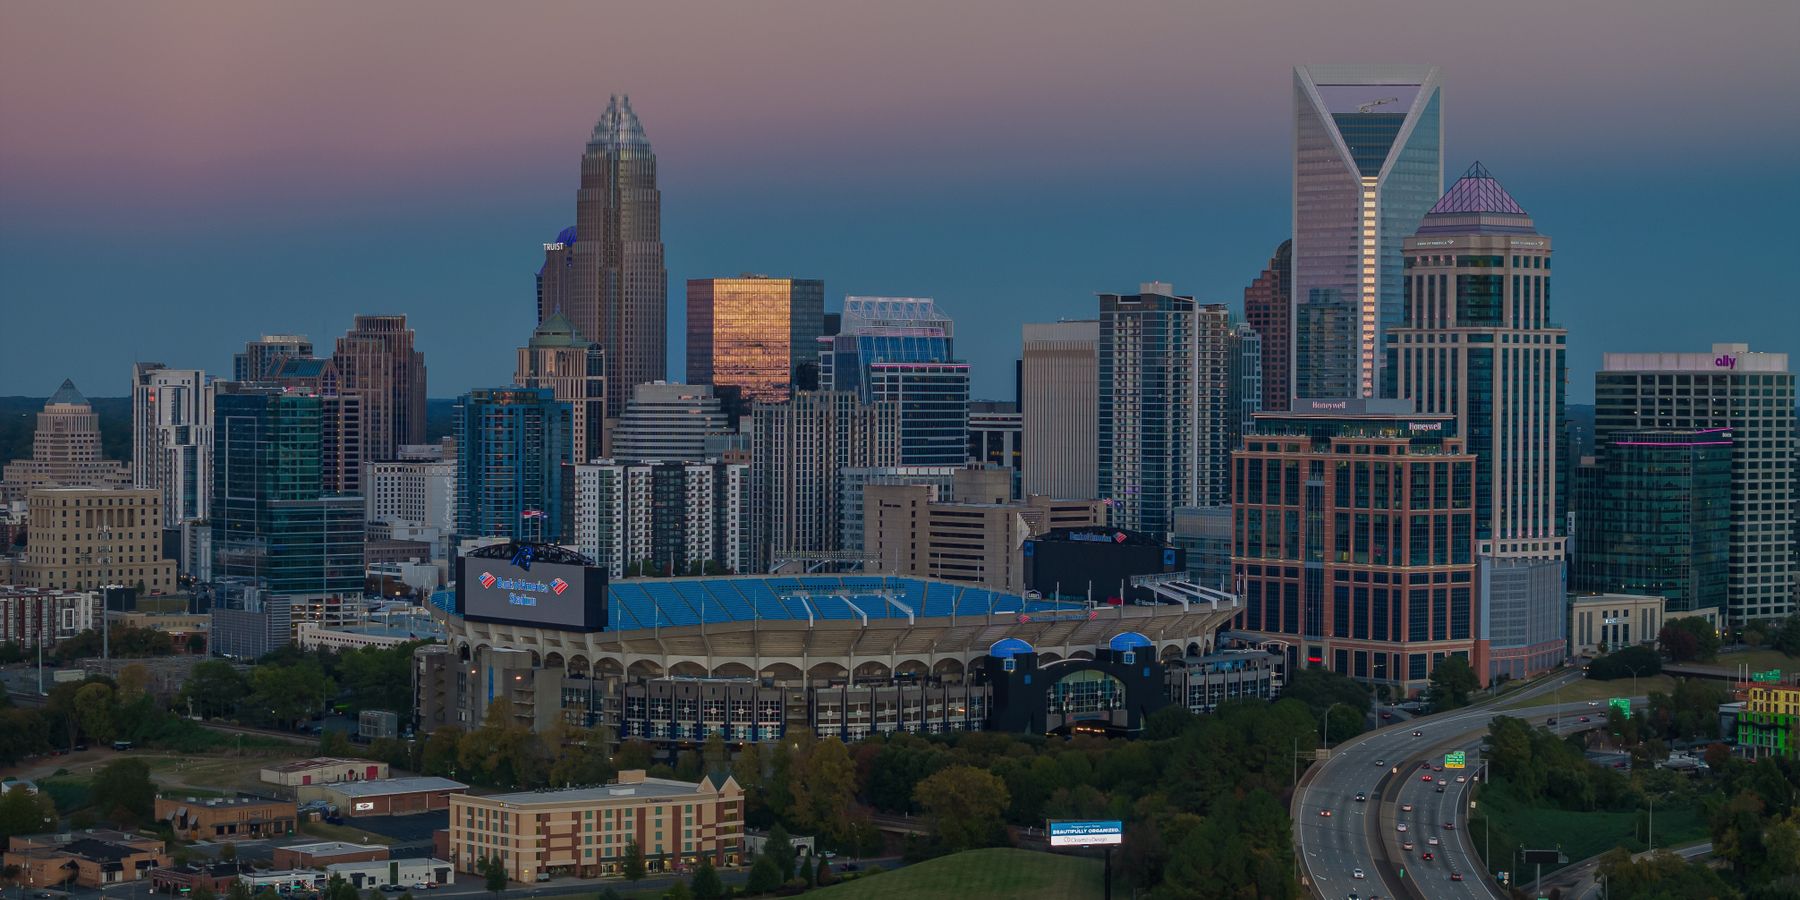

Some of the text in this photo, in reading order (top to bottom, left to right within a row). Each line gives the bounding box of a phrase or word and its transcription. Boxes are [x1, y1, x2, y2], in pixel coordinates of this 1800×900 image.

[543, 242, 564, 251] TRUIST
[1715, 355, 1736, 370] ally
[1312, 401, 1346, 410] Honeywell
[1409, 422, 1442, 431] Honeywell
[496, 576, 514, 590] Bank
[520, 579, 548, 593] America
